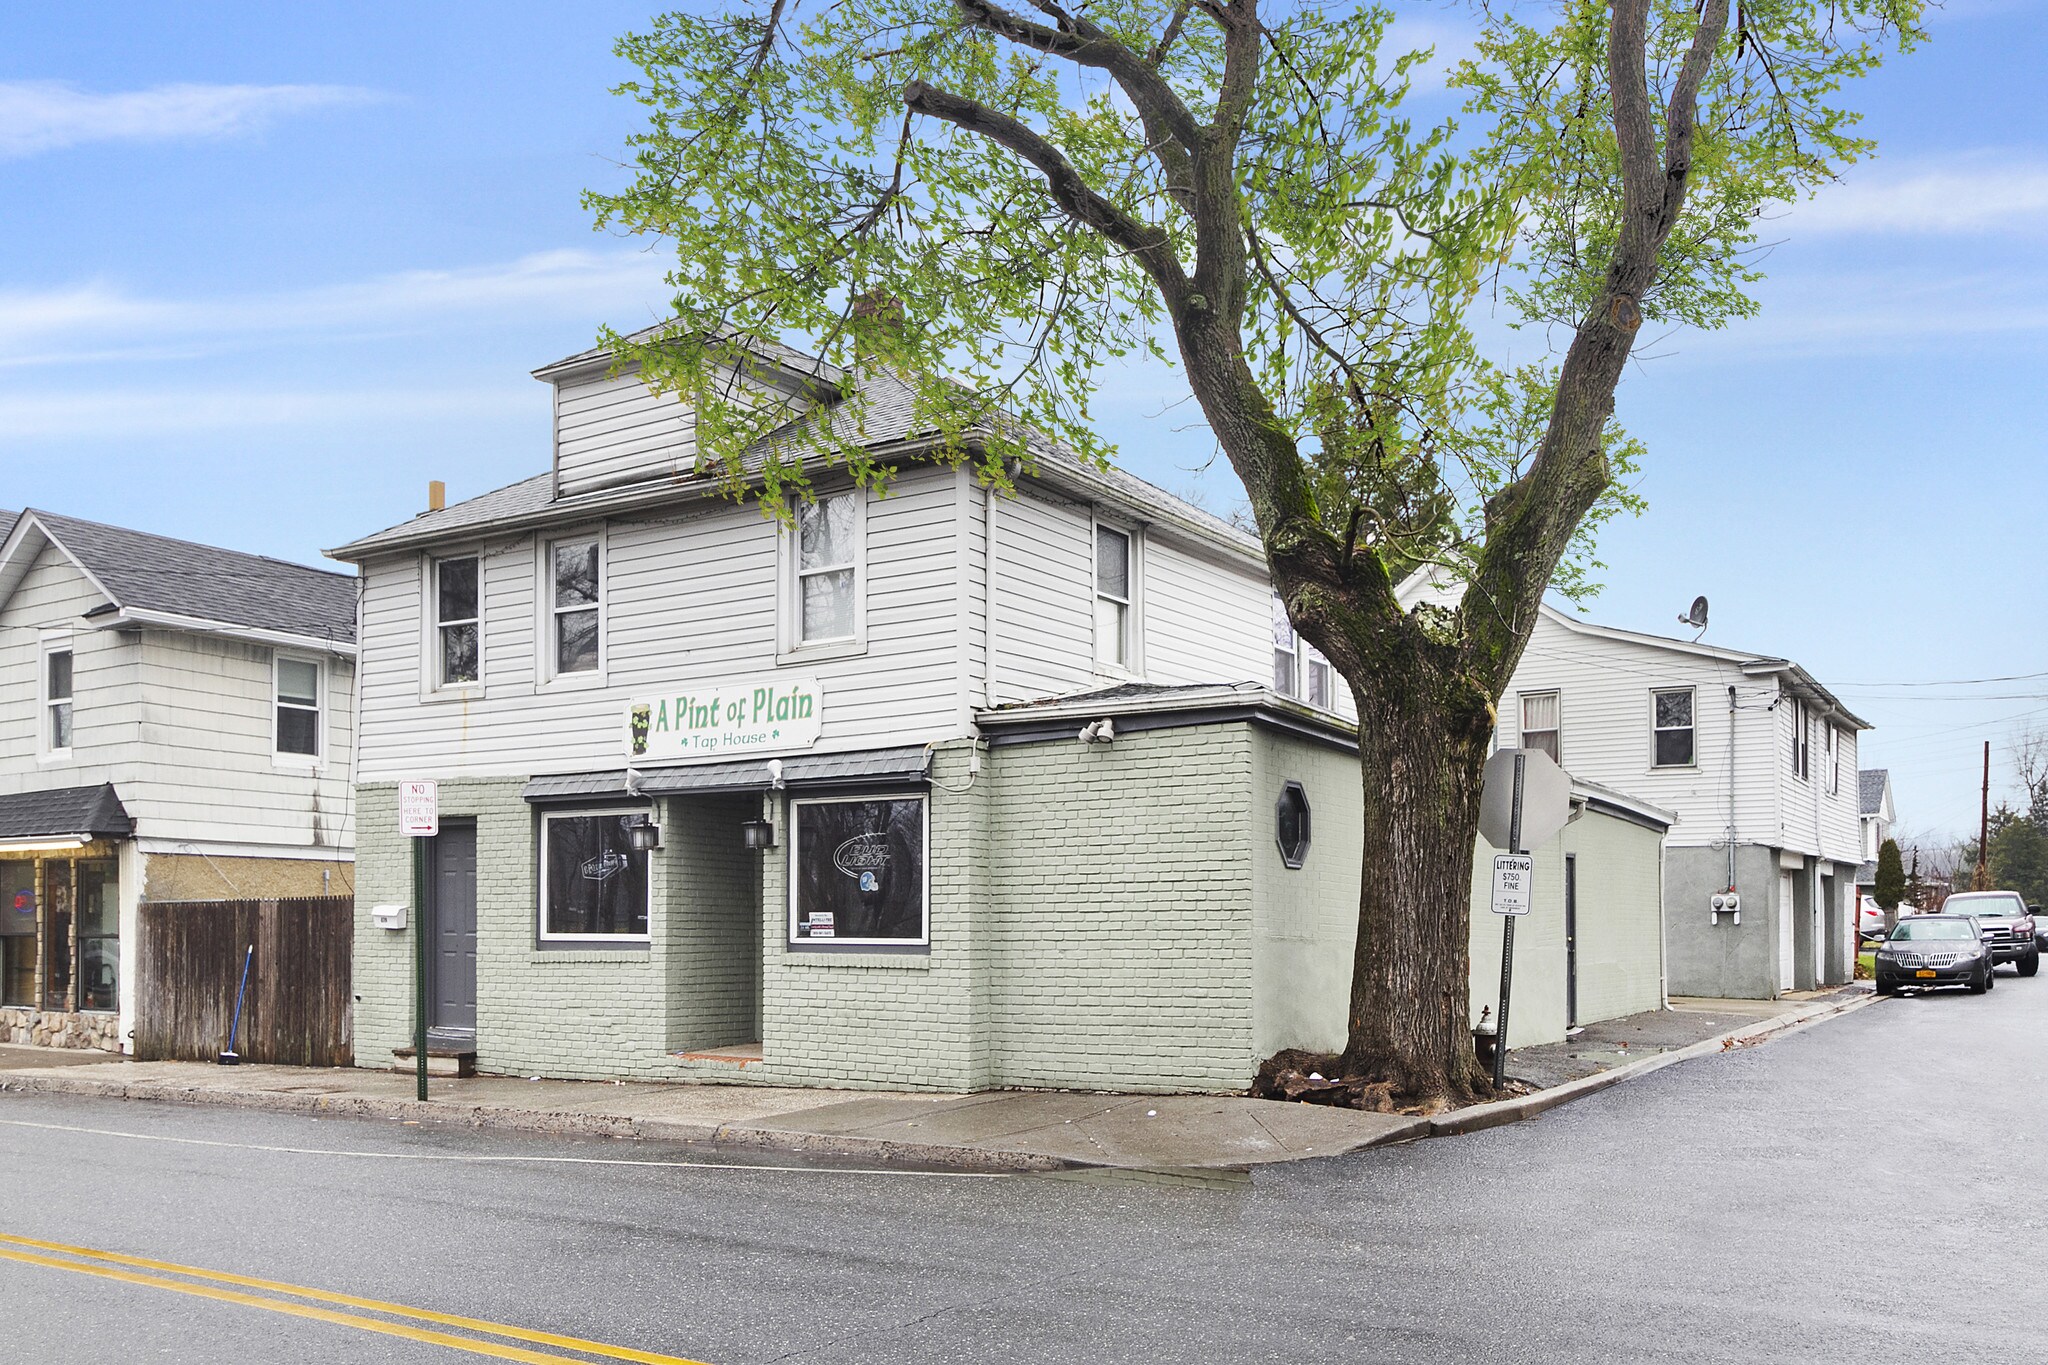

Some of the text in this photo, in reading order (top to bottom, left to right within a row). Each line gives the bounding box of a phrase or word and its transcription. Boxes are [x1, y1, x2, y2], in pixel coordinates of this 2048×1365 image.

[655, 686, 813, 732] A Pint of Plain
[693, 732, 767, 751] Tap House
[411, 784, 425, 794] NO
[403, 807, 434, 815] HERE TO
[849, 844, 888, 856] BUD
[840, 854, 891, 866] LIGHT
[1496, 860, 1530, 871] LITTERING
[1503, 882, 1519, 890] FINE
